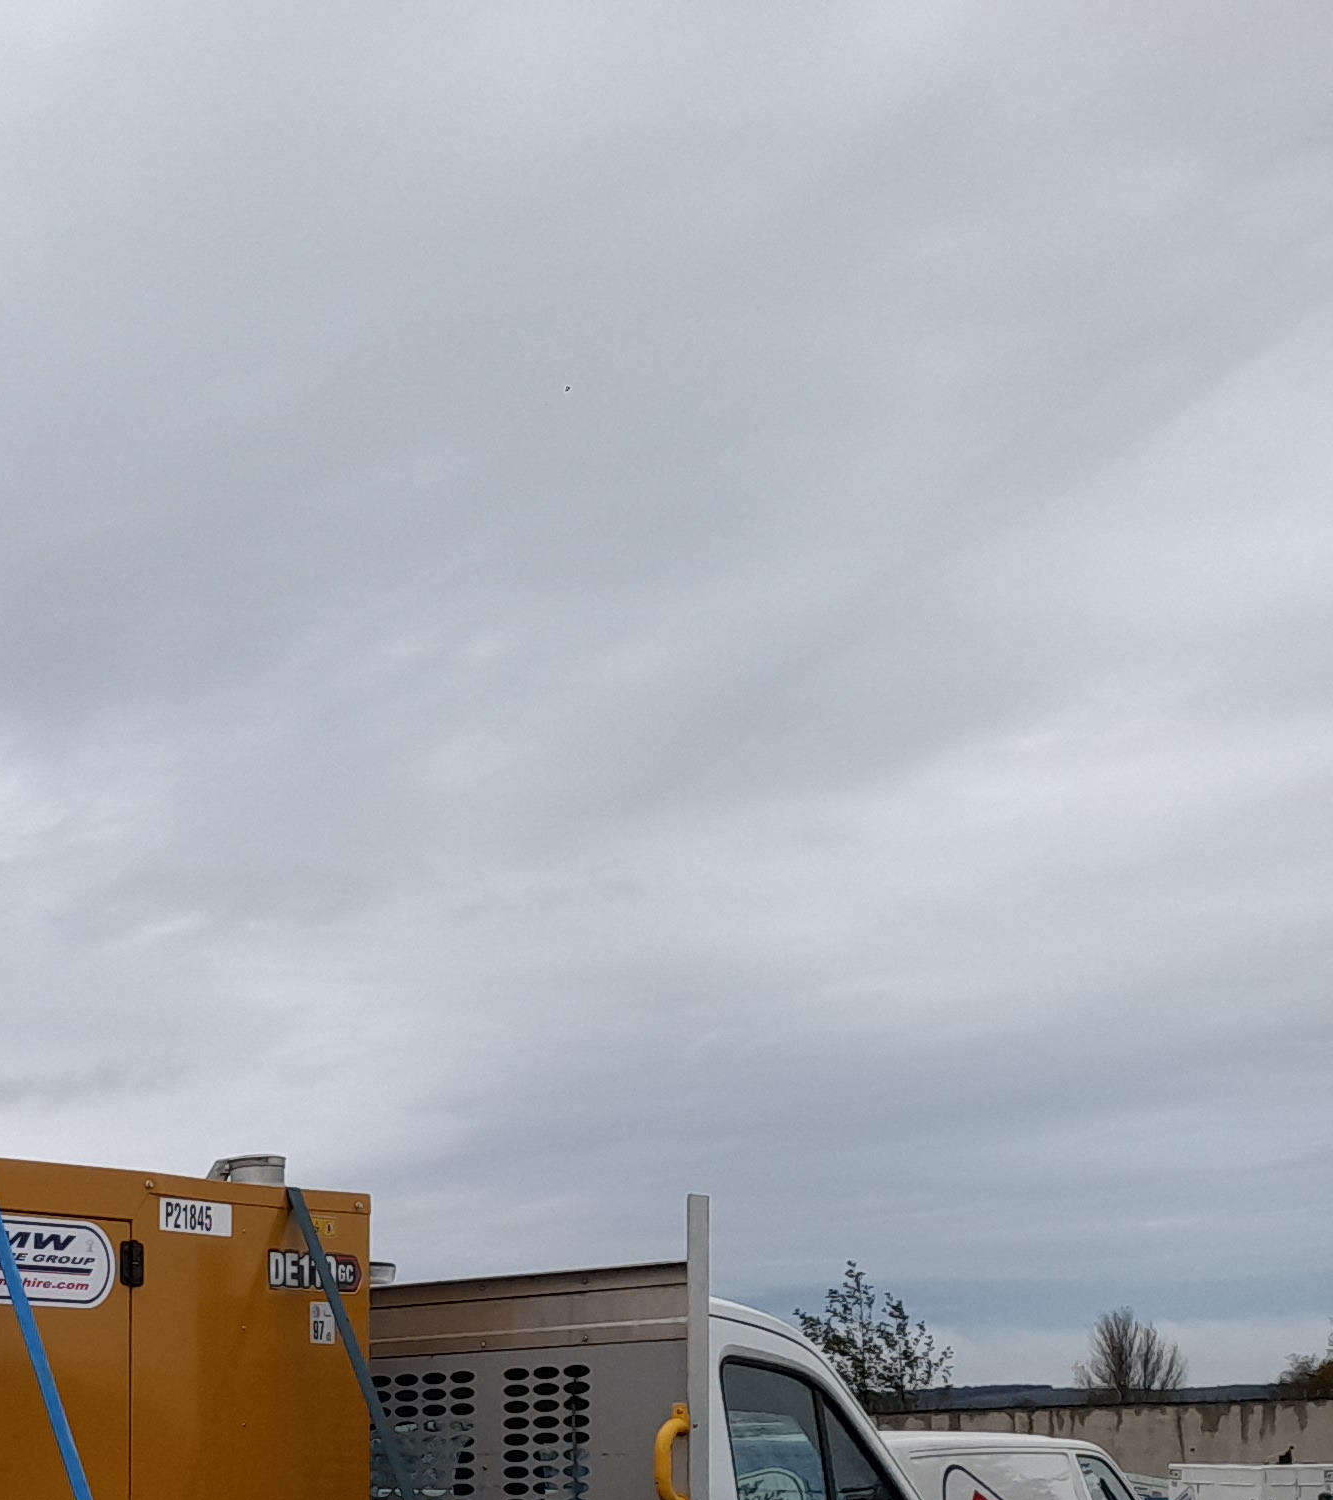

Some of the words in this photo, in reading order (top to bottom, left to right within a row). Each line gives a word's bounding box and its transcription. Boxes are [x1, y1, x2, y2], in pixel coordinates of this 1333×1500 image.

[165, 1201, 213, 1232] P21845
[32, 1253, 96, 1266] GROUP
[337, 1264, 354, 1283] GC
[312, 1320, 325, 1340] 97
